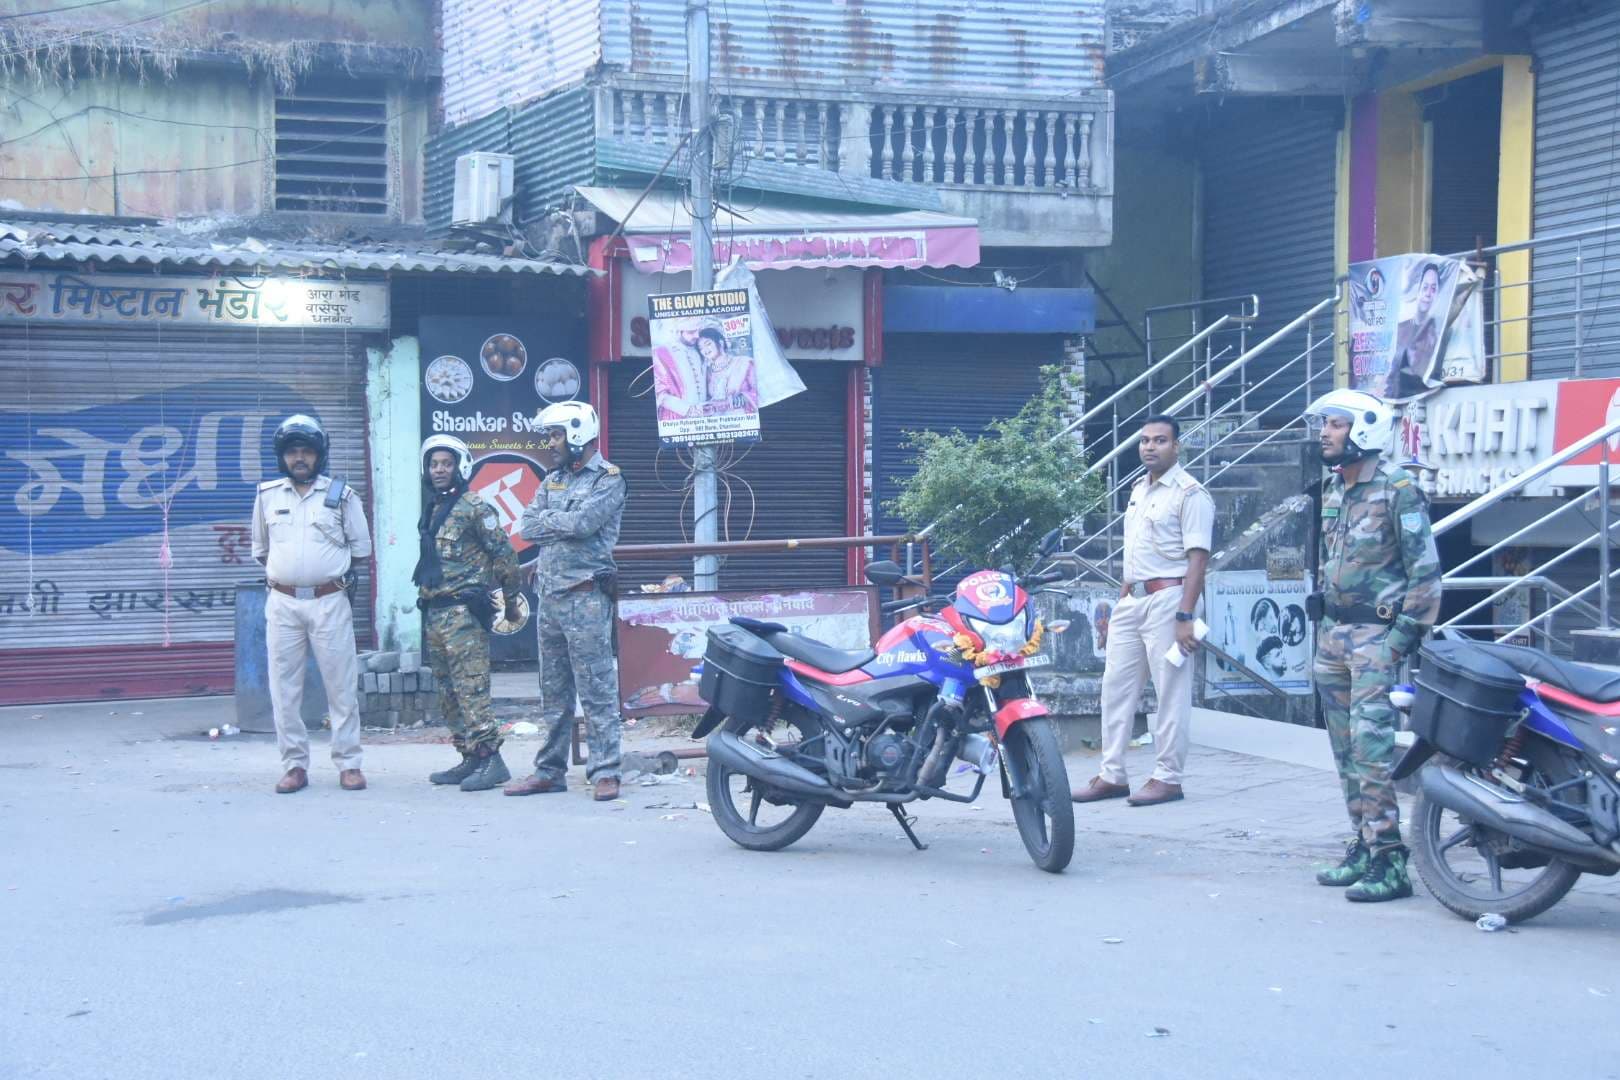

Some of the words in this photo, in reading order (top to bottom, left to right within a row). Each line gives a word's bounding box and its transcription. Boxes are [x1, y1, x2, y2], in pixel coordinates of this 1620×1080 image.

[48, 275, 188, 318] मिष्टान
[652, 297, 673, 311] THE
[674, 294, 705, 310] GLOW
[707, 291, 746, 308] STUDIO
[655, 310, 680, 318] UNISEX
[680, 308, 704, 316] SALON
[711, 305, 745, 313] ACADEMY
[432, 410, 507, 432] Shankar
[489, 438, 522, 450] Sweets
[959, 572, 1012, 591] POLICE
[1267, 583, 1306, 595] SALOON
[876, 653, 893, 667] City
[896, 649, 927, 663] Hawks
